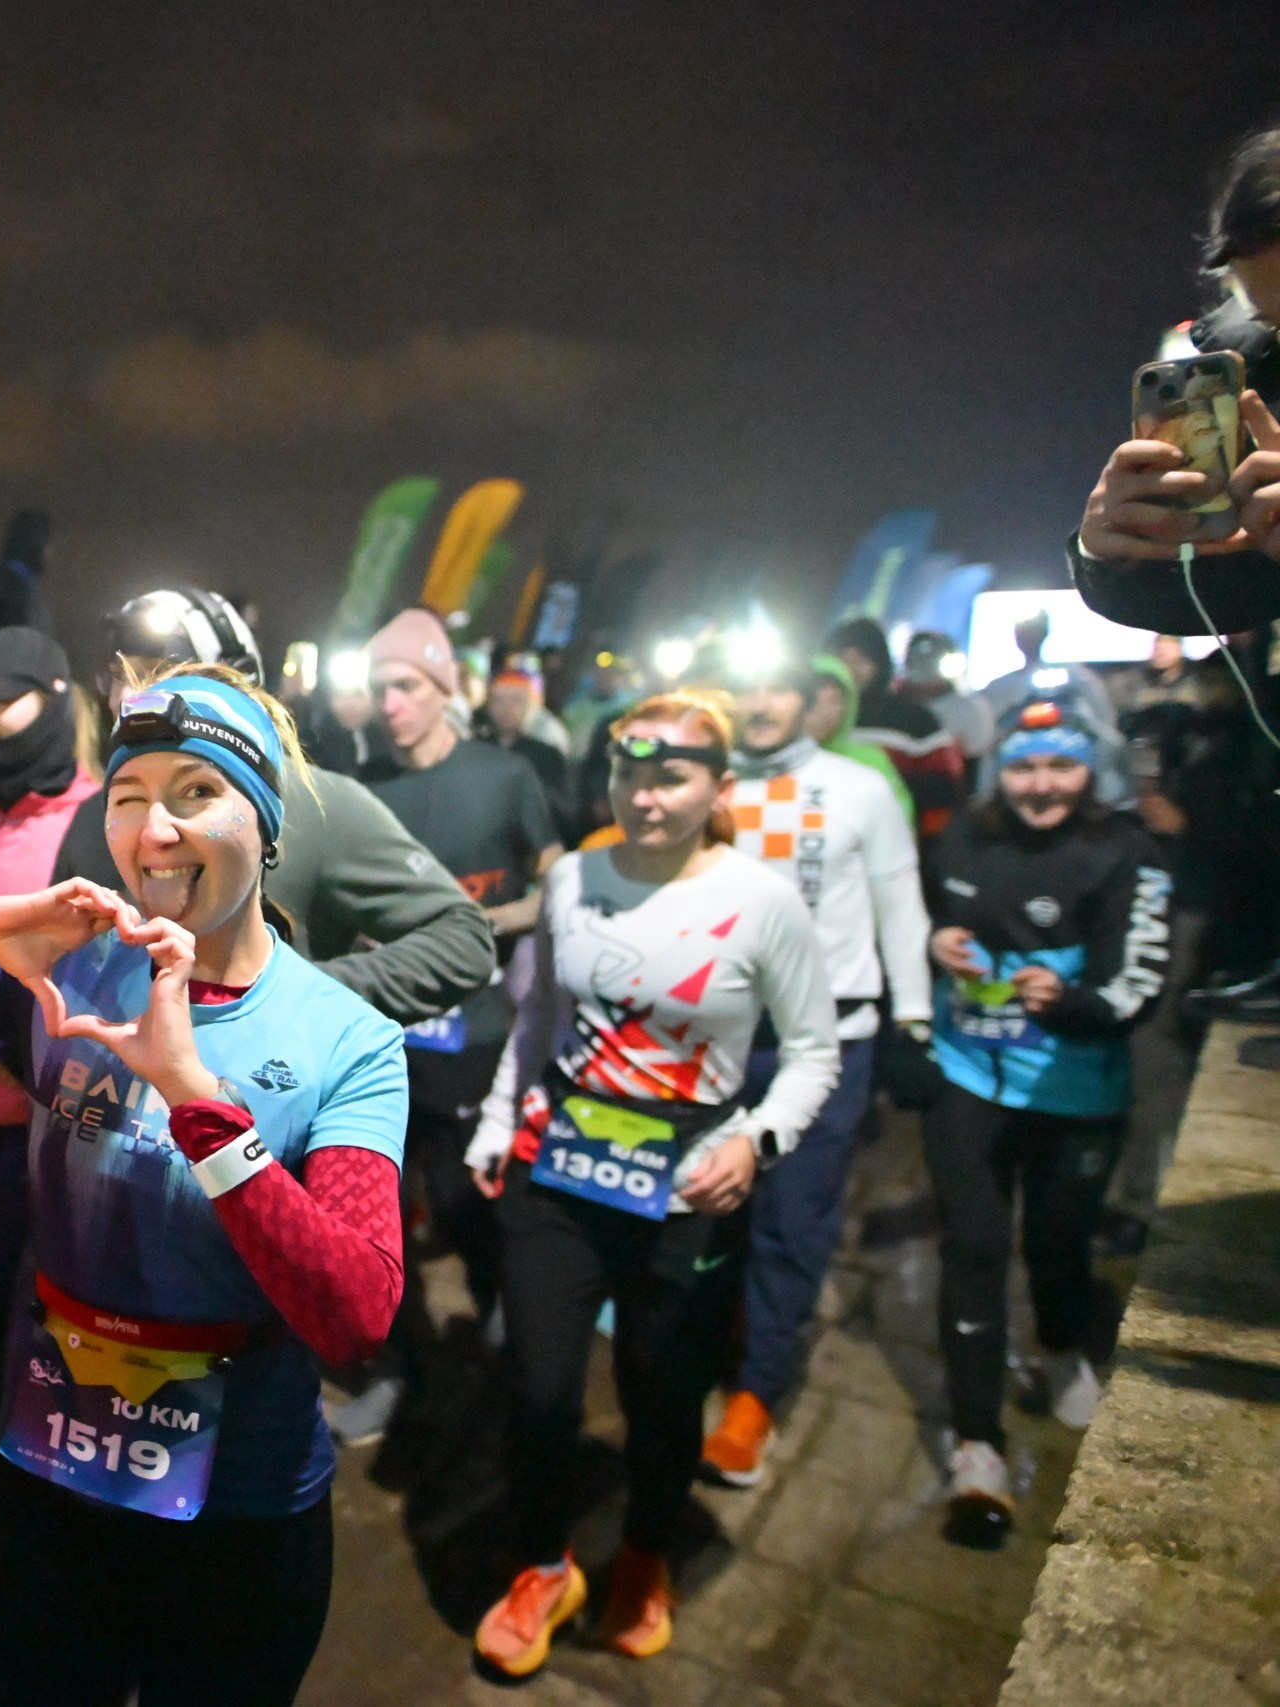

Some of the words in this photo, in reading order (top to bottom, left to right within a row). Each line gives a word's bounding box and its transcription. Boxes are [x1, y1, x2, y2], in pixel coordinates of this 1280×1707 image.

[252, 1070, 268, 1078] ICE
[272, 1074, 300, 1085] TRAIL
[262, 1064, 293, 1077] Baikal
[51, 1094, 105, 1128] ICE
[550, 1147, 657, 1199] 1300
[111, 1396, 144, 1421] 10
[149, 1404, 200, 1433] KM
[46, 1411, 171, 1481] 1519
